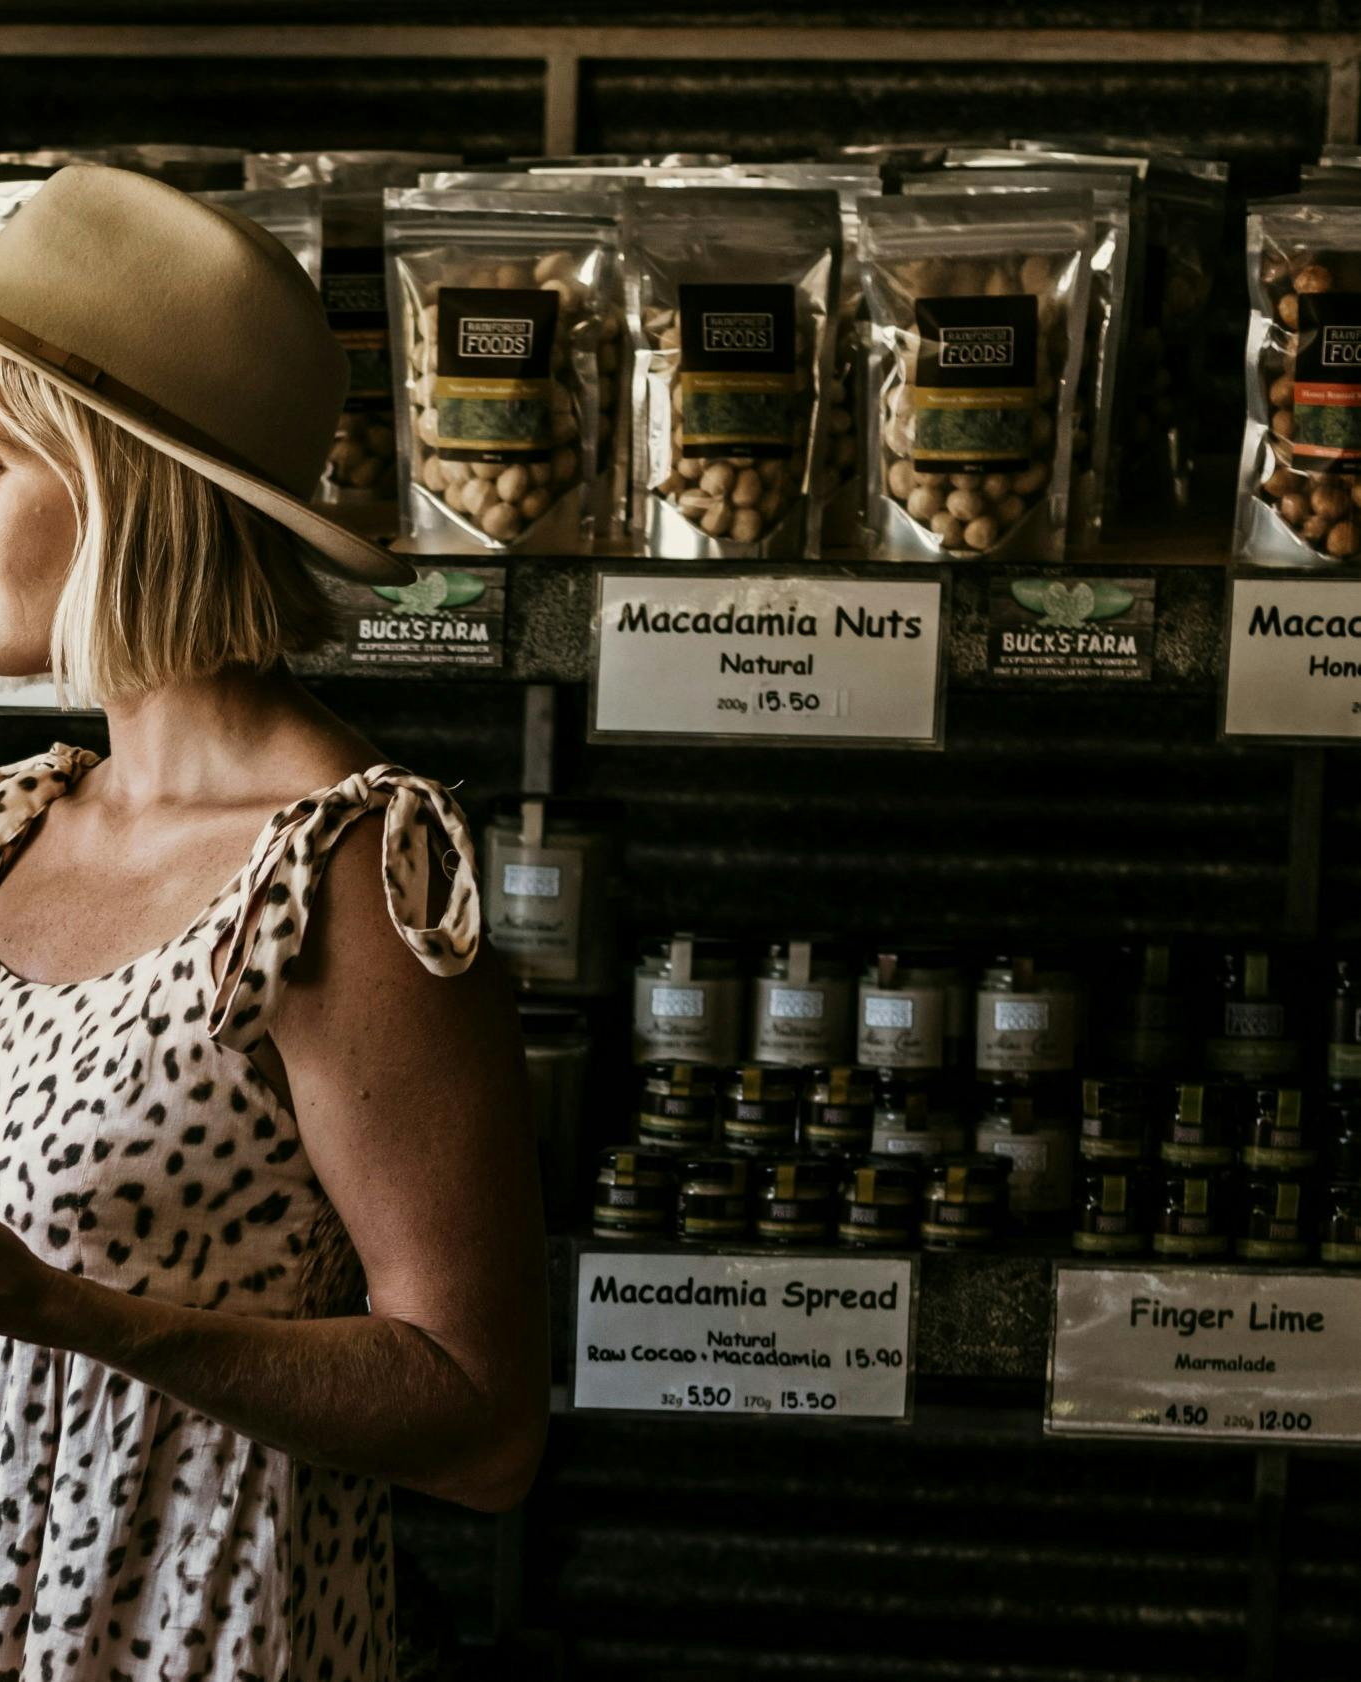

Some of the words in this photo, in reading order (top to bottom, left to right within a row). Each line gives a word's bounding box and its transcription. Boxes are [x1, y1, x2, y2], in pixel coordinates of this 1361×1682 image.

[466, 336, 526, 354] FOODS
[711, 330, 767, 347] FOODS
[948, 344, 1007, 362] FOODS
[430, 620, 489, 642] FARM
[617, 601, 818, 637] Macadamia
[834, 605, 923, 639] Nuts
[1077, 634, 1138, 656] FARM
[720, 652, 814, 676] Natural
[717, 697, 748, 713] 200g
[758, 690, 820, 711] 15.50
[589, 1276, 767, 1307] Macadamia
[781, 1281, 898, 1317] Spread
[1130, 1298, 1234, 1336] Finger
[1249, 1301, 1325, 1333] Lime
[707, 1330, 776, 1349] Natural
[588, 1346, 625, 1361] Raw
[712, 1347, 831, 1369] Macadamia
[845, 1348, 903, 1368] 15.90
[1174, 1353, 1276, 1373] Marmalade
[660, 1393, 683, 1408] 32g
[687, 1385, 732, 1407] 5.50
[743, 1396, 772, 1411] 170g
[781, 1391, 837, 1410] 15.50
[1165, 1403, 1209, 1425] 4.50
[1259, 1411, 1312, 1431] 12.00
